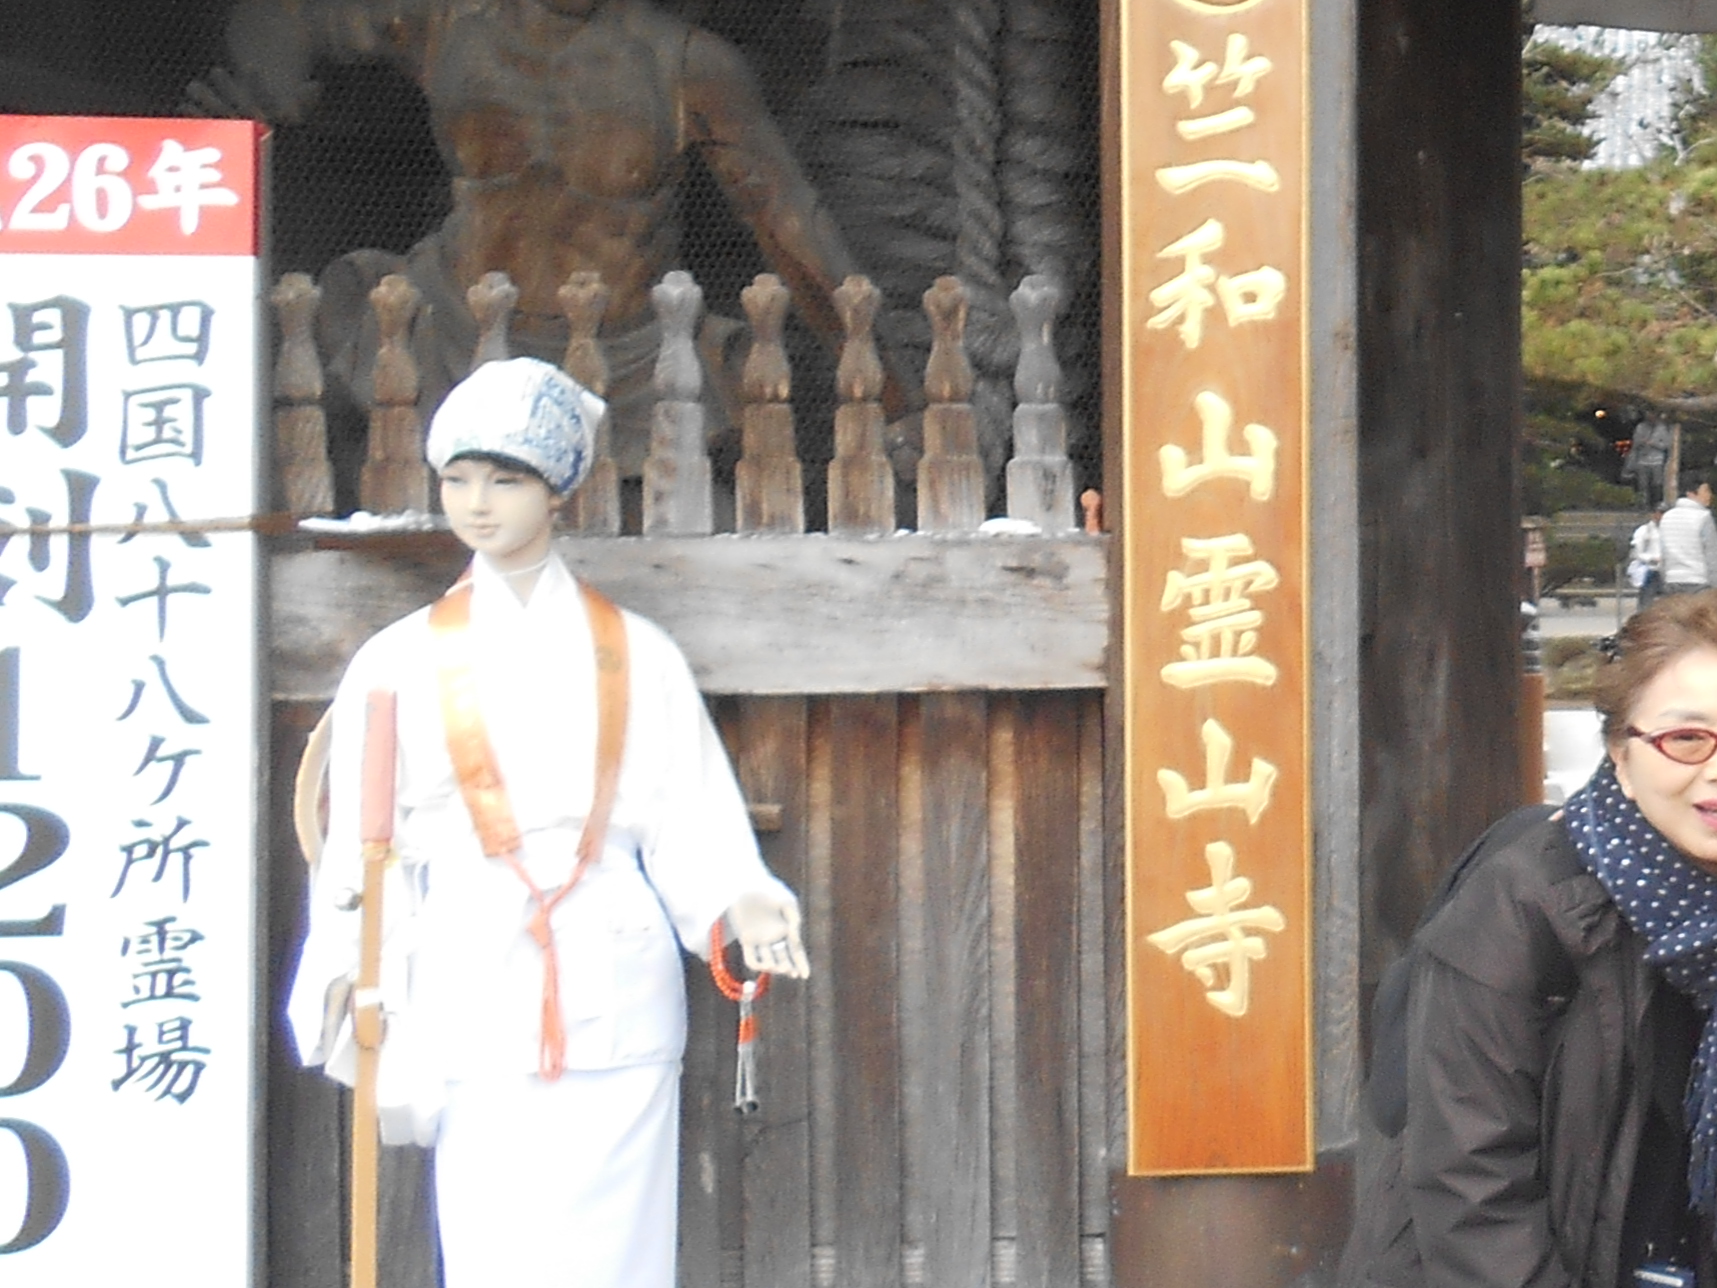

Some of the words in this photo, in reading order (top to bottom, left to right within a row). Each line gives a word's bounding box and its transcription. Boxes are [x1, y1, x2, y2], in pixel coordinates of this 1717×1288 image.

[0, 138, 240, 236] 26年
[1147, 32, 1287, 1017] 竺和山霊山寺
